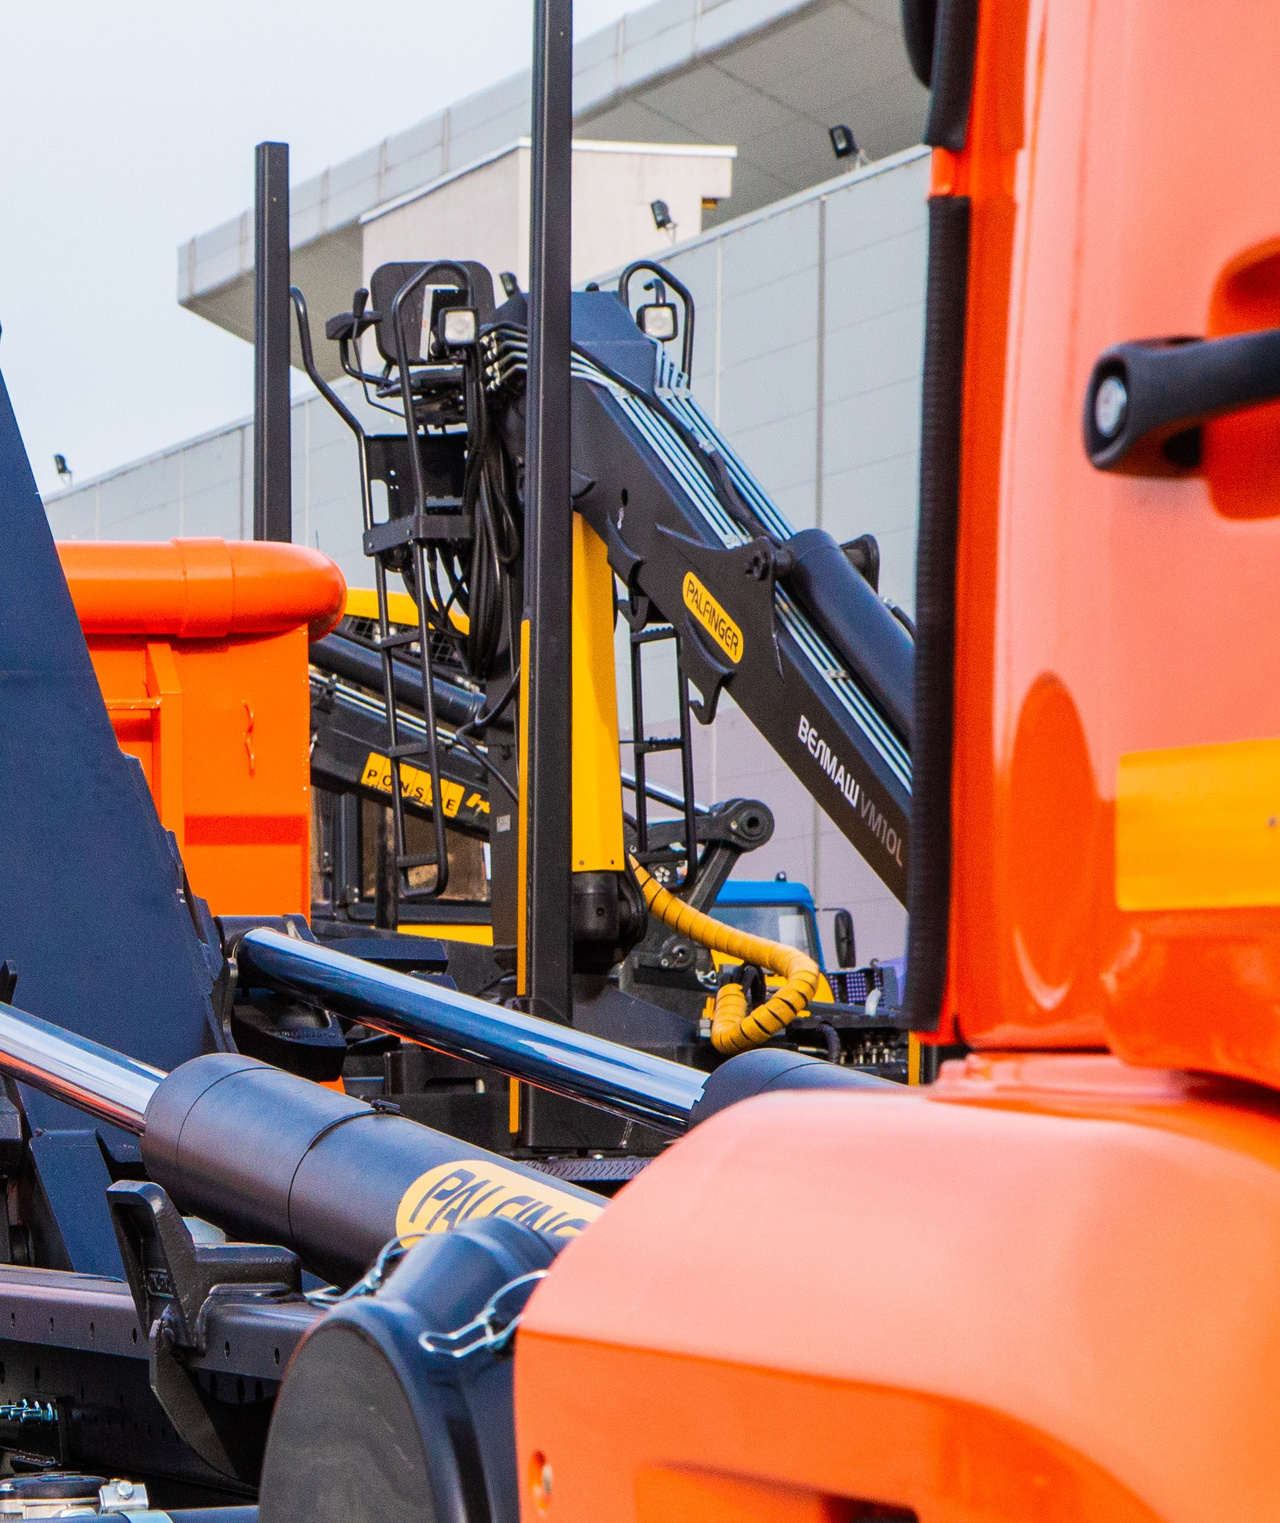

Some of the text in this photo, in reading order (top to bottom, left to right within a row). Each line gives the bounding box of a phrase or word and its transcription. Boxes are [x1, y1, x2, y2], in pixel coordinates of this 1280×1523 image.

[686, 580, 739, 656] PALFINGER
[367, 769, 456, 812] PONSE
[797, 715, 860, 809] ВЕЛМАШ
